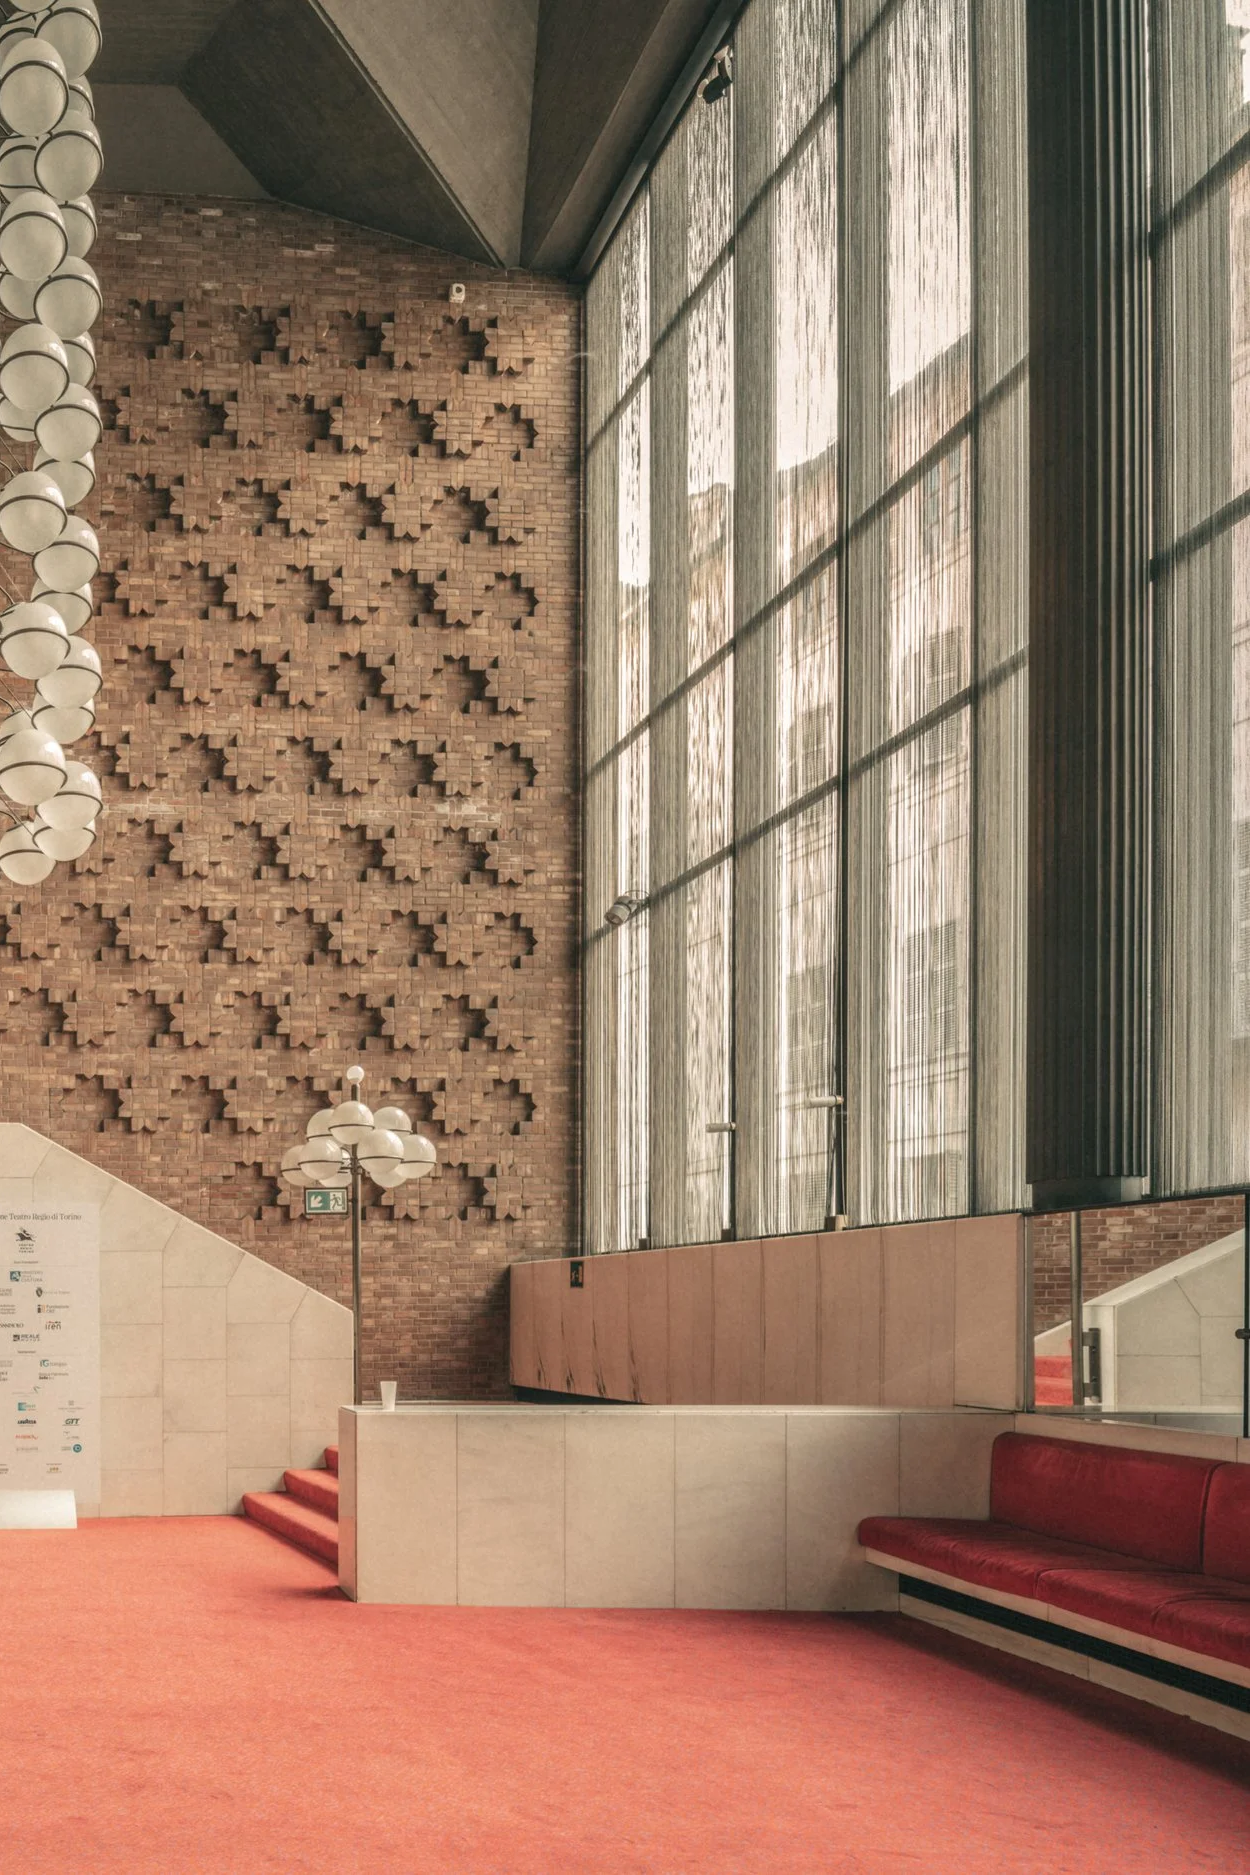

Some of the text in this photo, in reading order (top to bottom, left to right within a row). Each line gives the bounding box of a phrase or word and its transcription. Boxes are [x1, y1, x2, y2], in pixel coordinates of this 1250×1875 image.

[9, 1212, 31, 1220] Teatro
[32, 1212, 51, 1221] Regio
[51, 1212, 58, 1220] di
[59, 1212, 82, 1220] Torino
